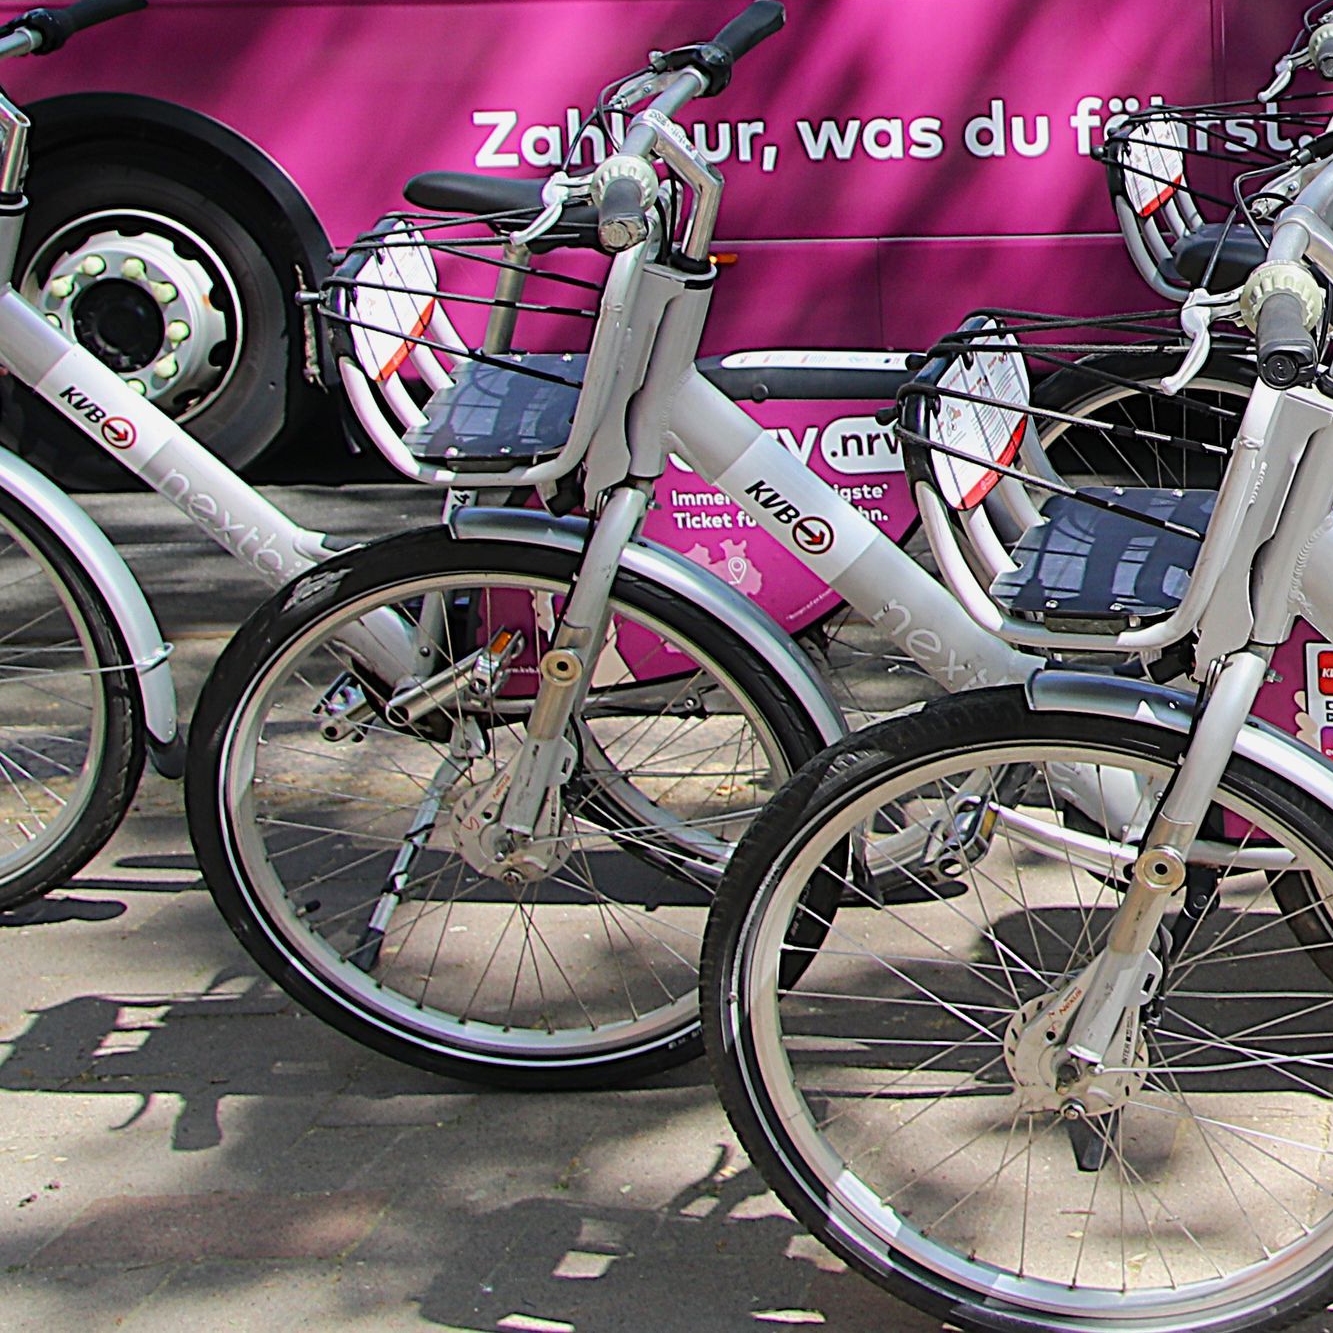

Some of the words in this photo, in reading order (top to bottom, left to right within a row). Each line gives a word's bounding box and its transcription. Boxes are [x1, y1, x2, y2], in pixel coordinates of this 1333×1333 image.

[697, 120, 779, 172] ur,
[796, 114, 944, 162] was
[963, 98, 1050, 160] du
[59, 385, 107, 424] KVB
[672, 511, 733, 530] Ticket
[744, 479, 801, 525] KVB
